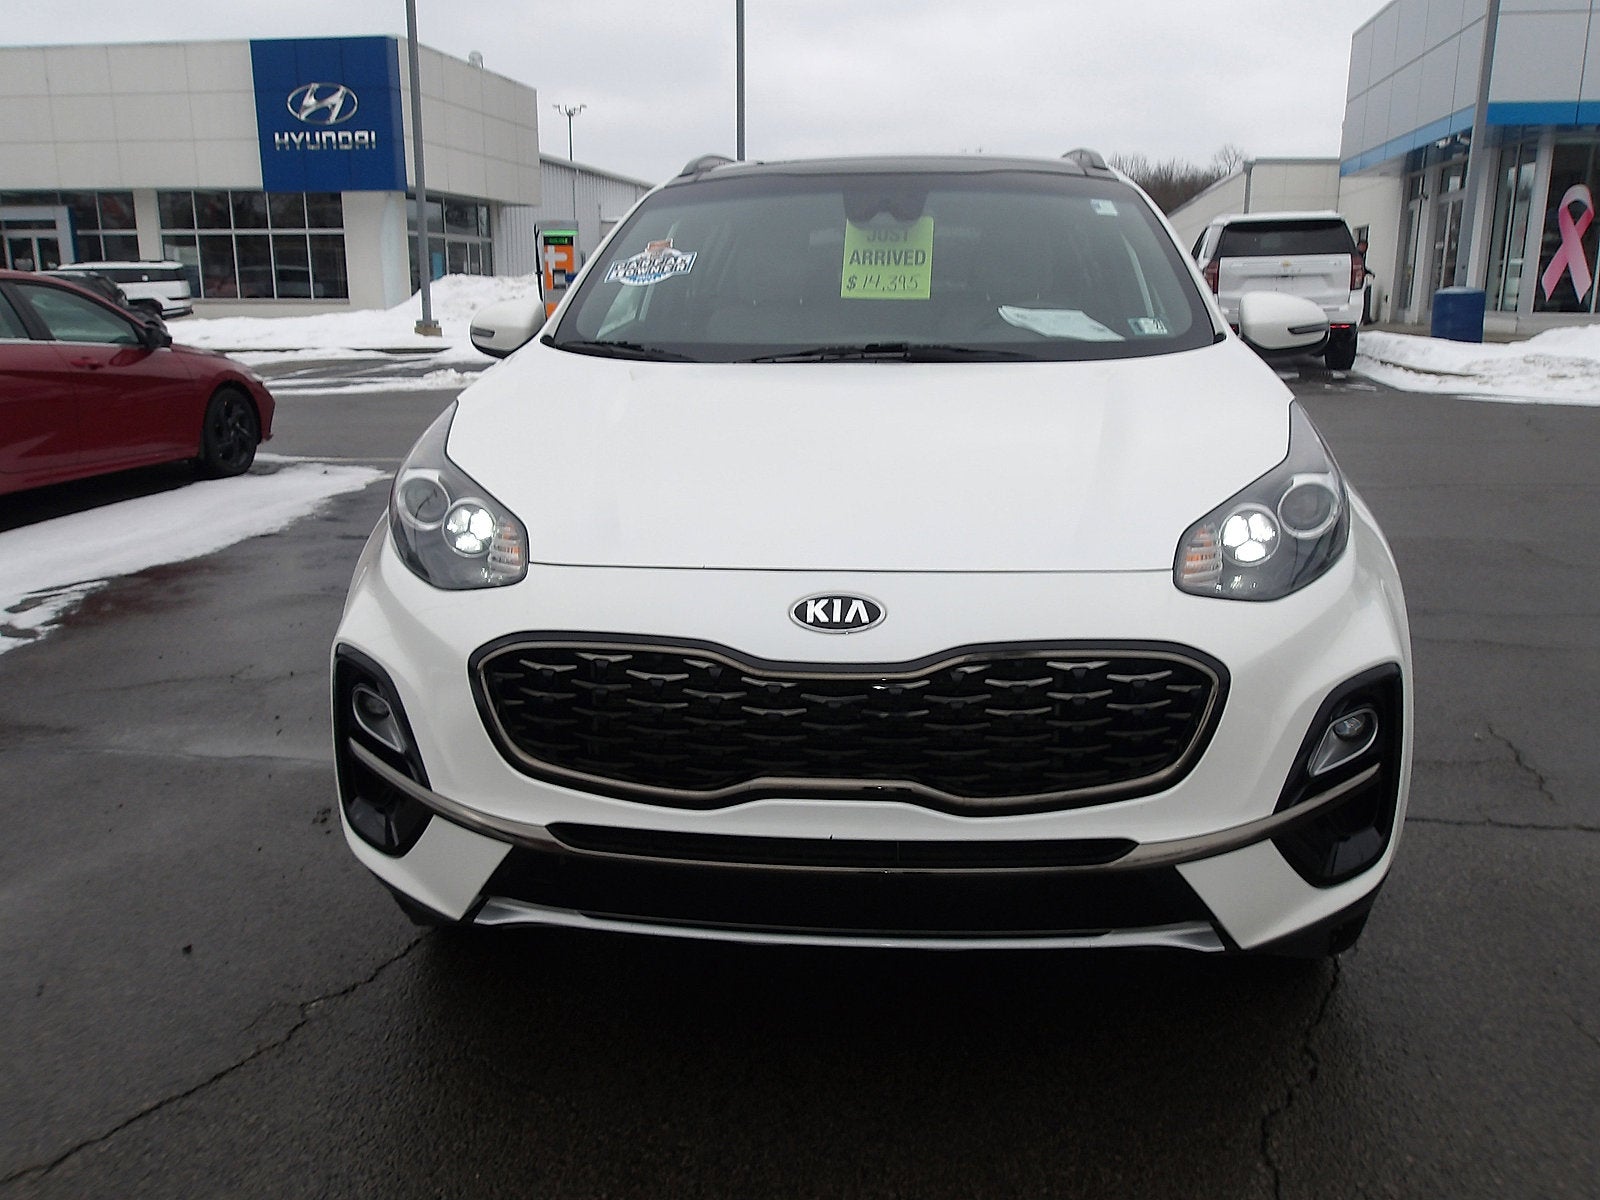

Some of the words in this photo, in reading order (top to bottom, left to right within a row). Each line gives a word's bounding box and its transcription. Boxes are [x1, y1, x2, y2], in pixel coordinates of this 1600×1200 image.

[274, 131, 376, 151] HYUNDAI
[849, 249, 926, 266] ARRIVED
[806, 598, 870, 623] KIA
